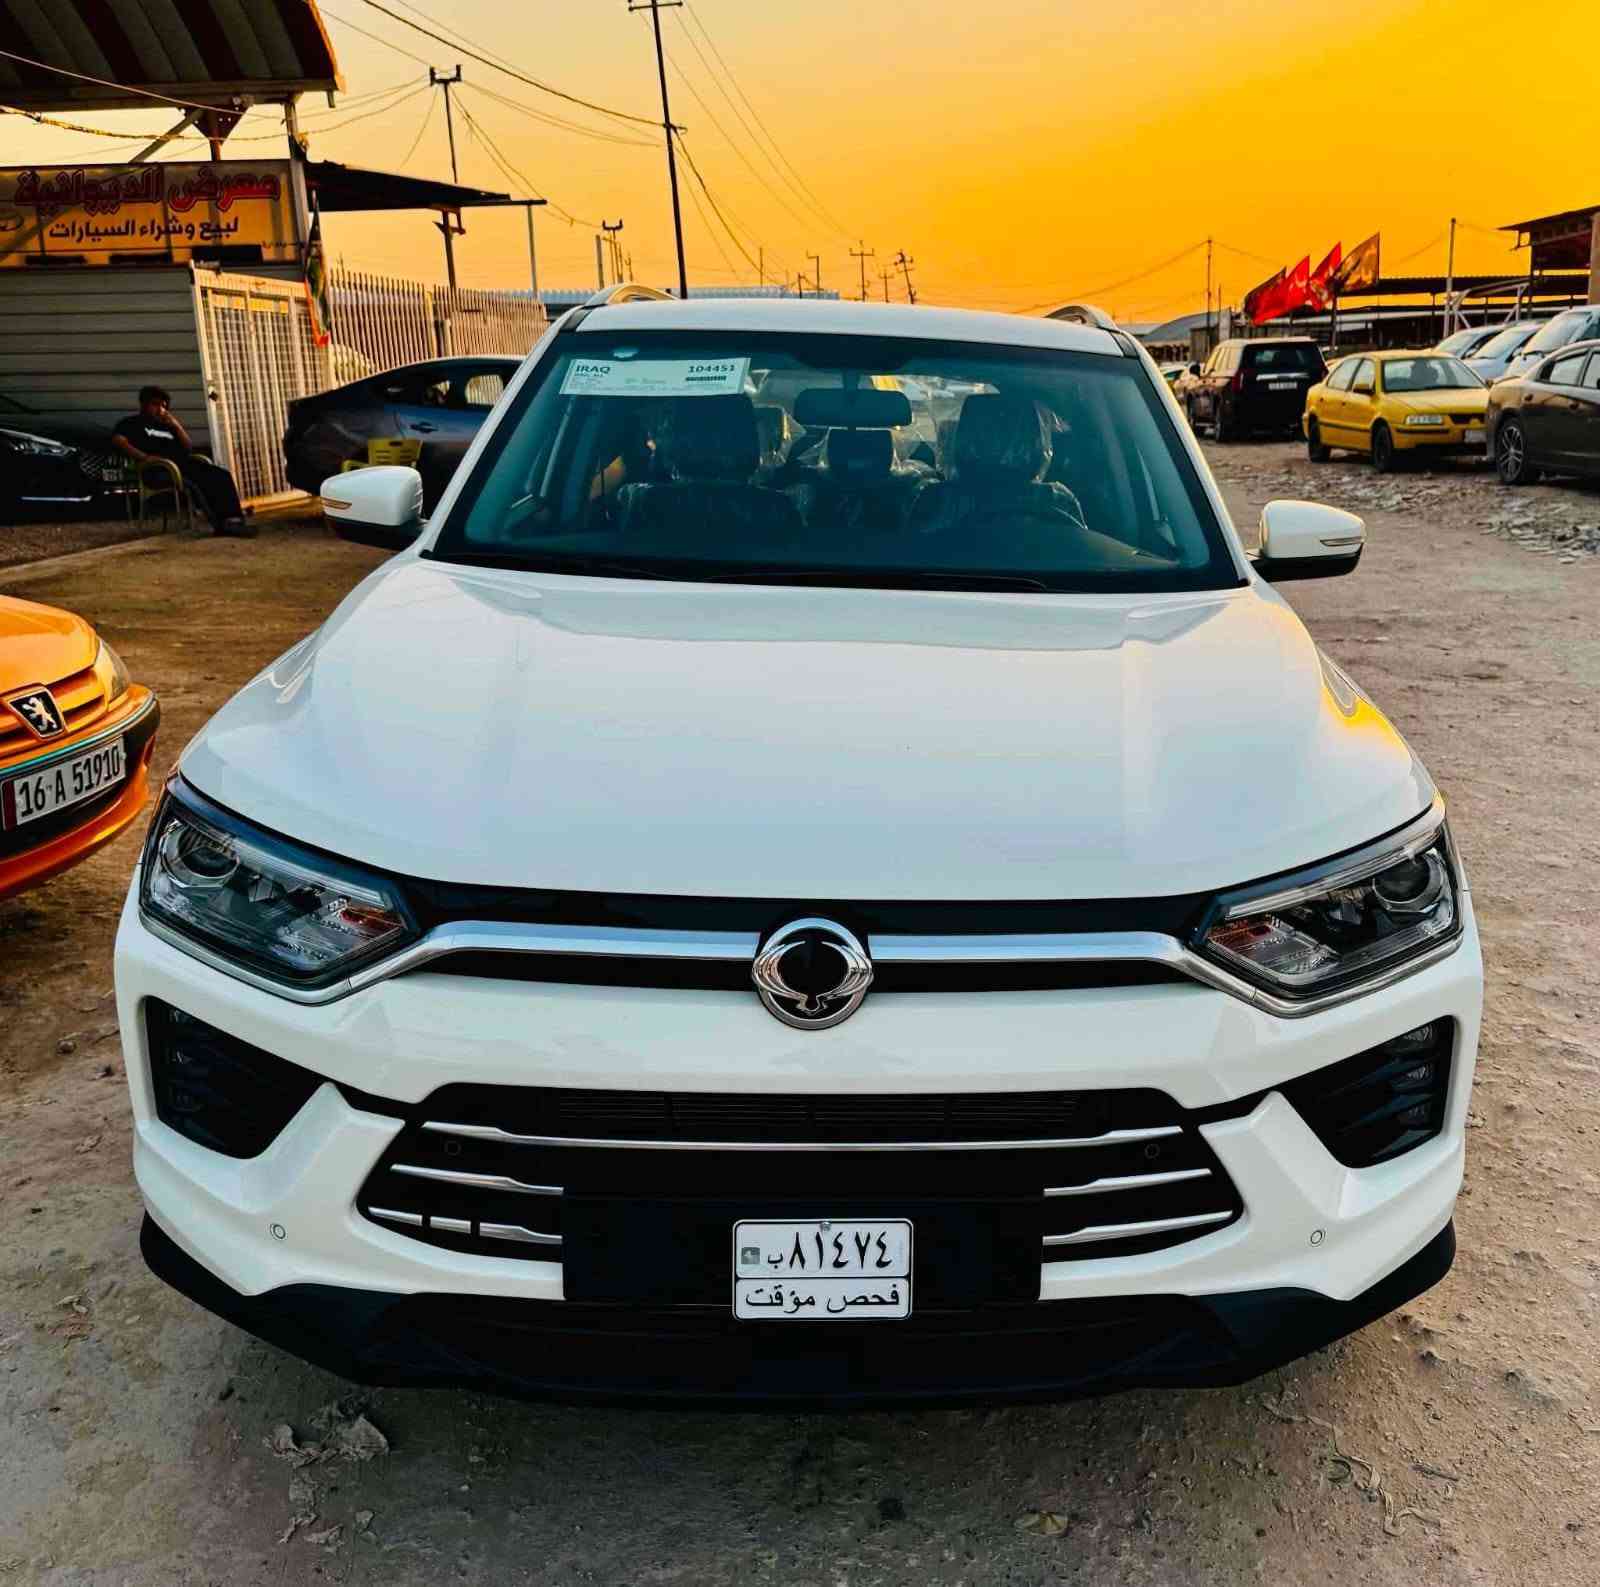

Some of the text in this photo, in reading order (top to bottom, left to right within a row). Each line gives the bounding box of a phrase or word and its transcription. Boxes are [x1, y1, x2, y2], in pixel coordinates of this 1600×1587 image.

[168, 168, 280, 212] معرض
[49, 215, 238, 243] لبيع وشراء السيارات
[576, 365, 610, 374] IRAQ
[688, 364, 735, 373] 104451
[19, 746, 120, 818] 16 A 51910
[788, 1230, 893, 1270] ٨١٤٧٤
[745, 1283, 900, 1315] فحص مؤقت
